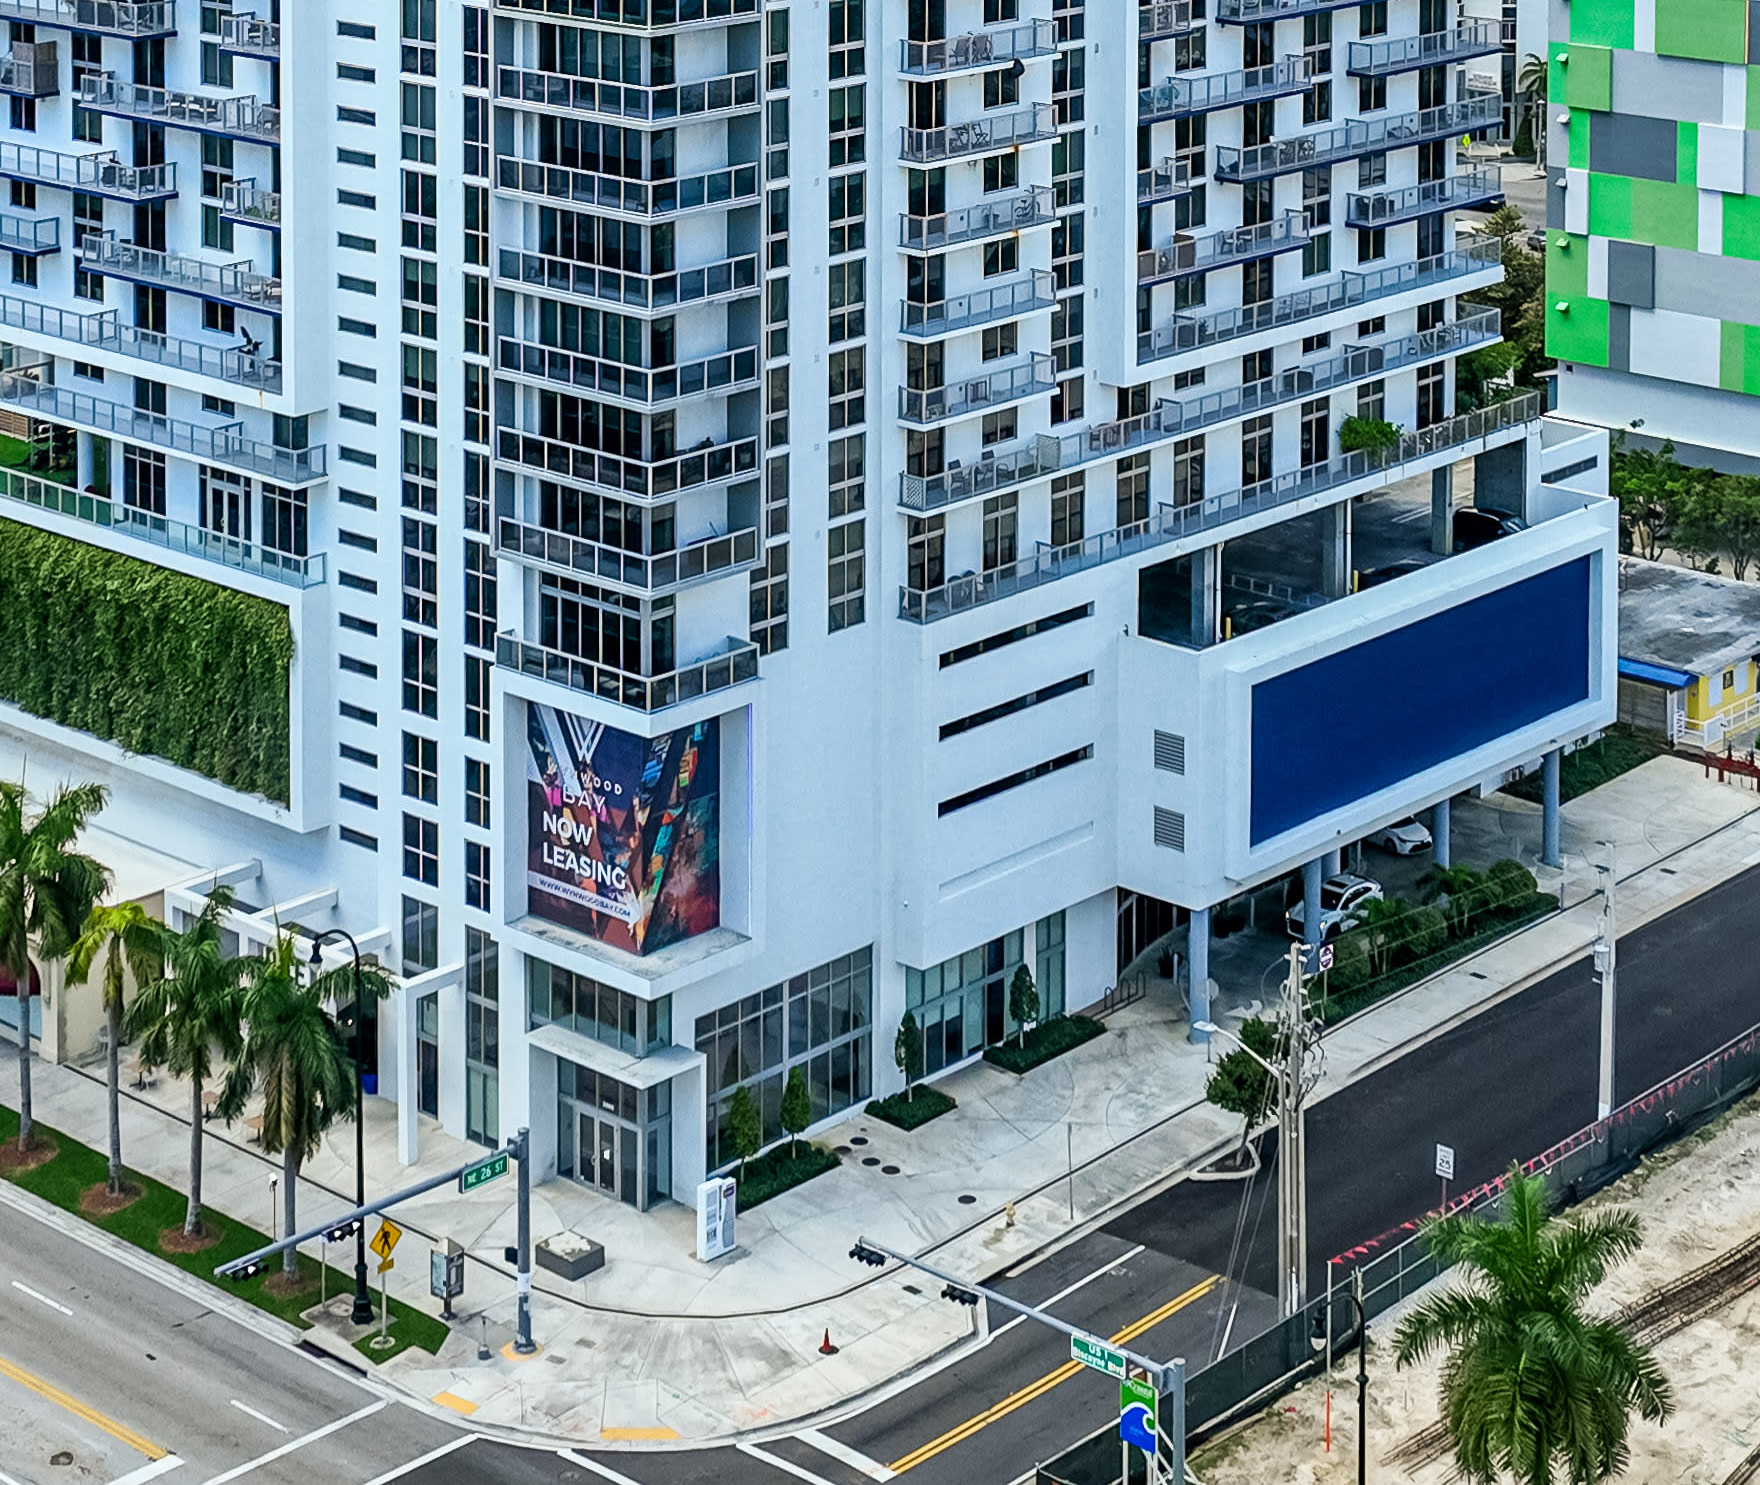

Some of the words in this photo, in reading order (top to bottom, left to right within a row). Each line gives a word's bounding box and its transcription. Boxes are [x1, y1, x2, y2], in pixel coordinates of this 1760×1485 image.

[542, 810, 593, 846] NOW
[542, 842, 627, 890] LEASING
[480, 1165, 492, 1181] 26
[494, 1160, 504, 1173] ST
[1439, 1158, 1451, 1170] 25
[1089, 1344, 1102, 1357] US
